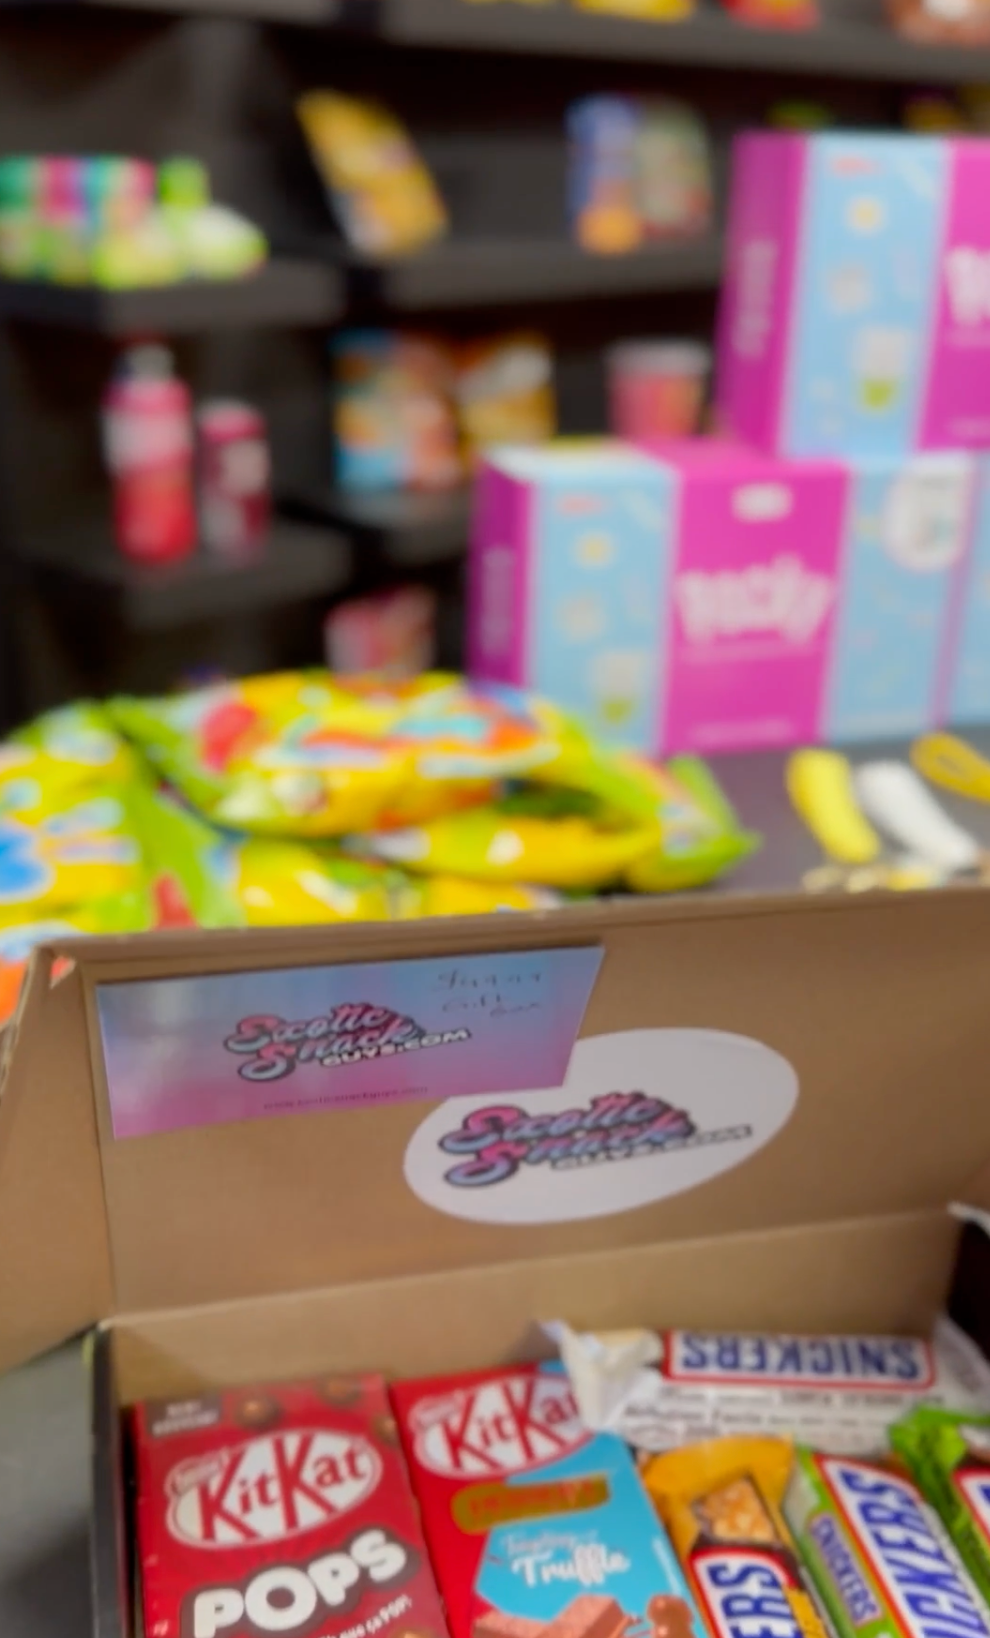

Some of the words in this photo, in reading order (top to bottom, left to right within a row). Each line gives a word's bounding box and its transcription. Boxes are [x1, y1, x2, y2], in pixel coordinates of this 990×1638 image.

[238, 1016, 426, 1082] Snack
[444, 1107, 697, 1187] Snack
[681, 1333, 918, 1380] SNICKERS
[198, 1432, 367, 1540] KitKat
[193, 1528, 407, 1638] POPS
[511, 1544, 632, 1587] Truffle
[811, 1514, 879, 1623] SNICKERS
